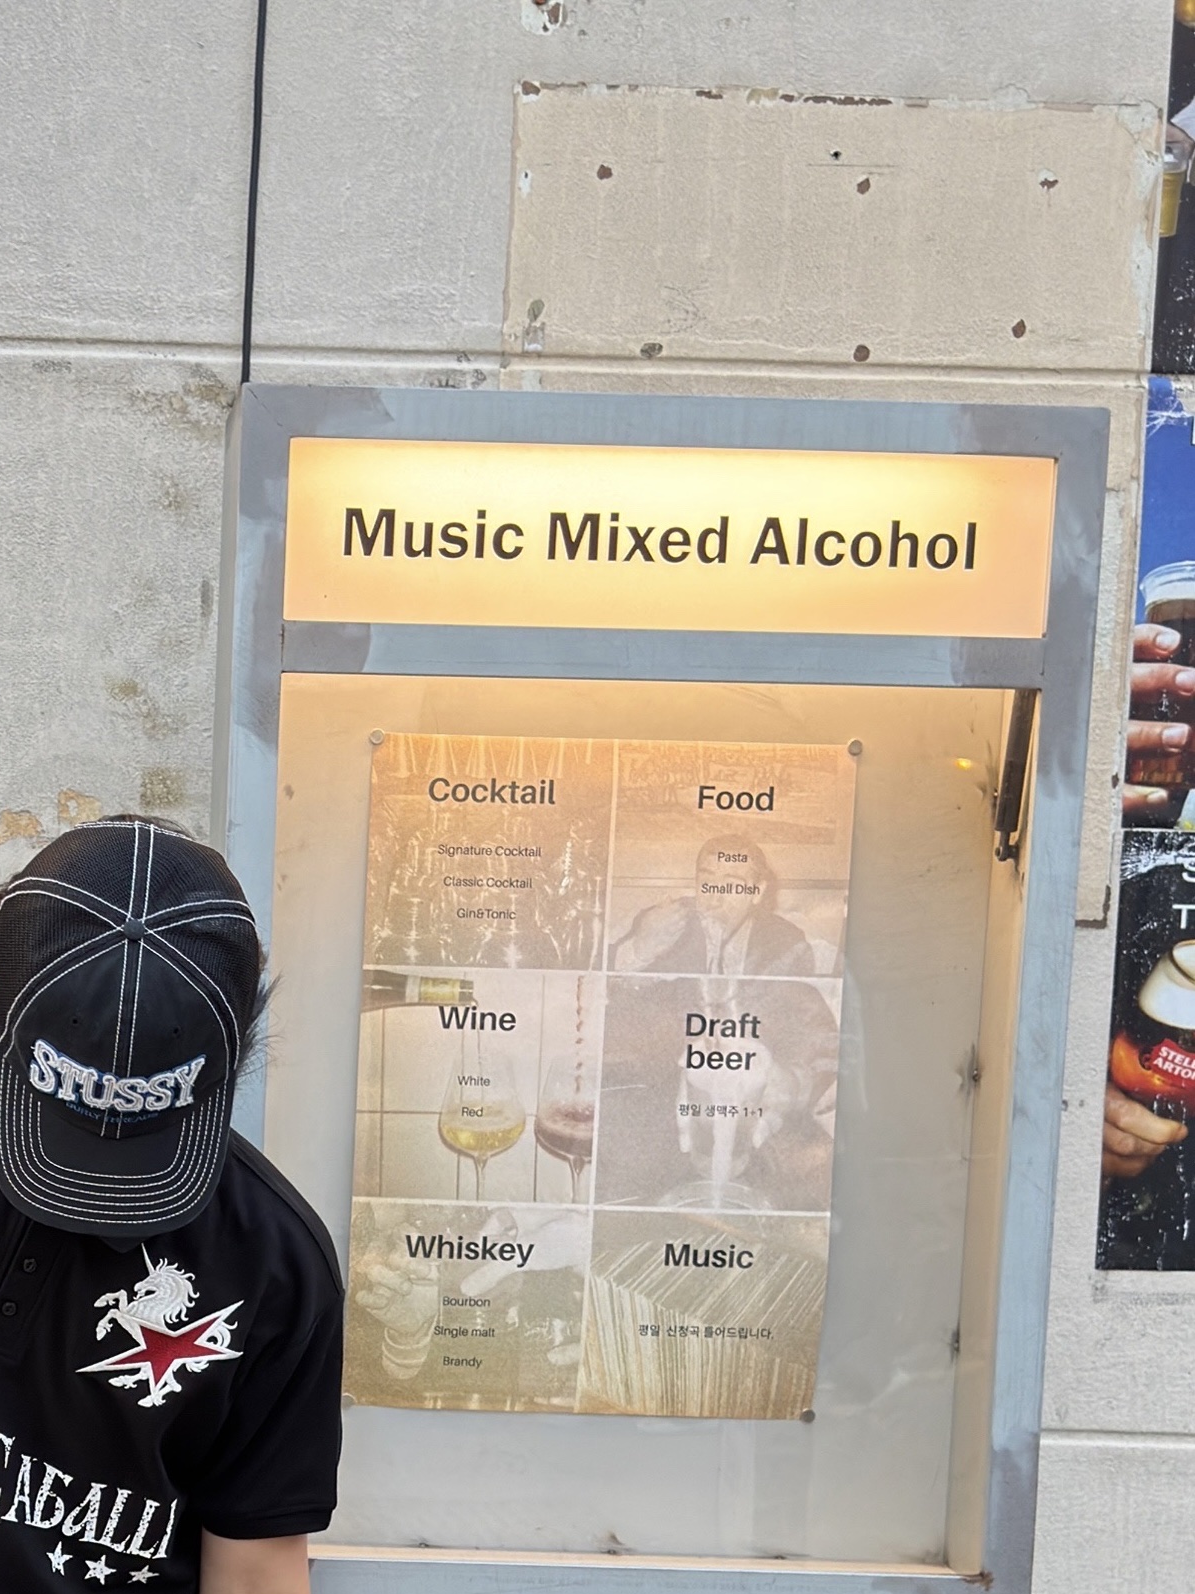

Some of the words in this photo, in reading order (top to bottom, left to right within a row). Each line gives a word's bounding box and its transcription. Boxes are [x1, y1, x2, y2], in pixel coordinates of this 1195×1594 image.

[342, 508, 524, 560] Music
[547, 510, 729, 565] Mixed
[749, 516, 978, 571] Alcohol
[428, 777, 556, 805] Cocktail
[698, 785, 775, 811] Food
[437, 844, 492, 858] Signature
[495, 845, 542, 858] Cocktail
[717, 852, 748, 863] Pasta
[443, 876, 484, 888] Classic
[486, 877, 533, 889] Cocktail
[701, 883, 732, 894] Small
[735, 883, 760, 895] Dish
[456, 908, 517, 920] Gin&Tonic
[439, 1005, 516, 1031] Wine
[685, 1012, 761, 1038] Draft
[686, 1044, 756, 1070] beer
[457, 1075, 490, 1086] White
[461, 1107, 483, 1118] Red
[679, 1104, 701, 1117] 평일
[705, 1104, 739, 1117] 생맥주
[405, 1234, 534, 1268] Whiskey
[664, 1243, 754, 1269] Music
[442, 1296, 490, 1308] Bourbon
[434, 1326, 469, 1338] Single
[471, 1327, 495, 1338] malt
[638, 1324, 660, 1337] 평일
[443, 1356, 482, 1369] Brandy
